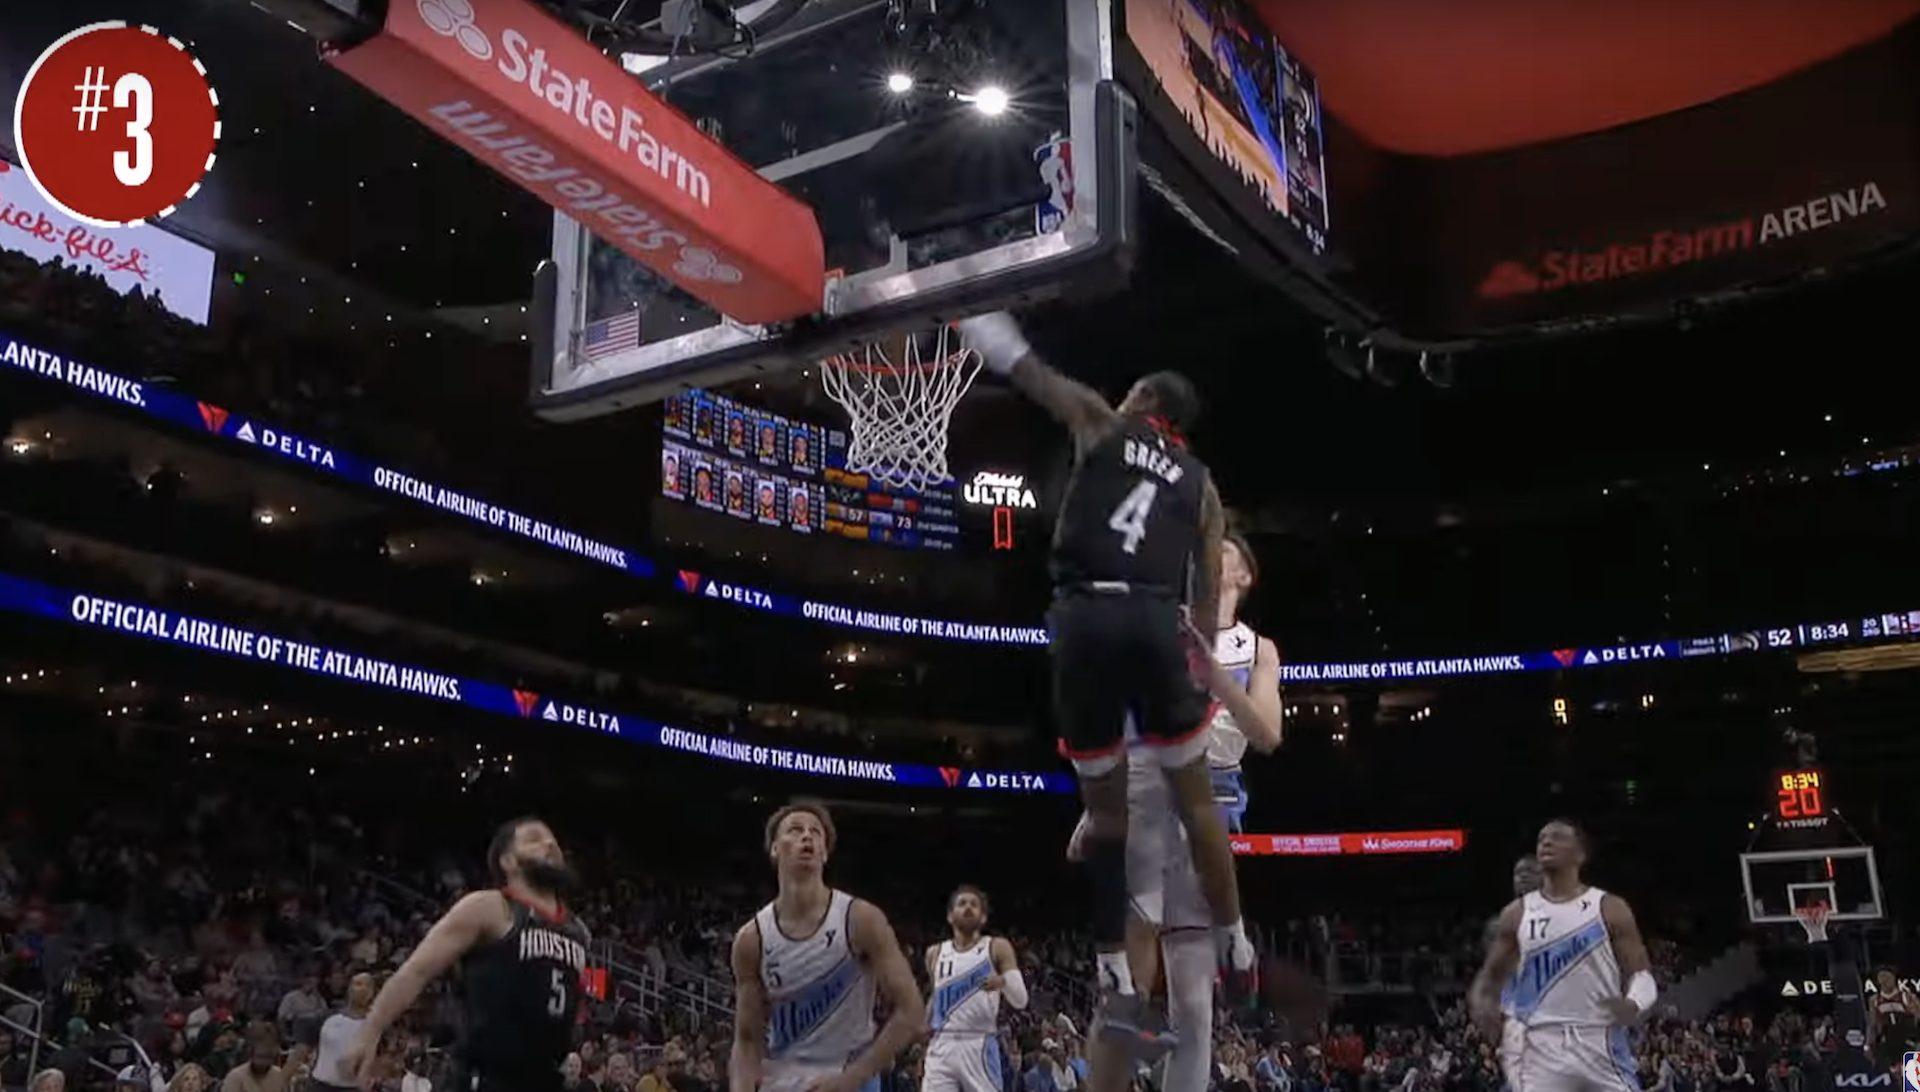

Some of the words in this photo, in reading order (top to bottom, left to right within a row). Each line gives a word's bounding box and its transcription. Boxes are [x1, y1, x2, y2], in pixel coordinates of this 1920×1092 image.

[500, 29, 711, 208] StateFarm
[1759, 181, 1887, 244] ARENA
[0, 203, 149, 281] ick-fil-A
[0, 341, 62, 379] ANTA
[67, 361, 146, 406] HAWKS.
[262, 429, 335, 468] DELTA
[963, 484, 1037, 508] ULTRA
[374, 467, 434, 504] OFFICIAL
[436, 489, 487, 522] AIRLINE
[489, 506, 506, 527] OF
[507, 512, 531, 537] THE
[532, 521, 583, 554] ATLANTA
[584, 539, 627, 568] HAWKS.
[1109, 480, 1158, 554] 4
[721, 584, 773, 609] DELTA
[802, 601, 853, 625] OFFICIAL
[855, 611, 901, 632] AIRLINE
[902, 617, 919, 634] OF
[920, 620, 943, 637] THE
[945, 623, 999, 641] ATLANTA
[1000, 627, 1050, 644] HAWKS.
[1767, 629, 1793, 647] 52
[1811, 623, 1849, 640] 8:34
[71, 595, 169, 638] OFFICIAL
[174, 617, 253, 656] AIRLINE
[256, 635, 282, 661] OF
[285, 641, 320, 670] THE
[321, 650, 398, 688] ATLANTA
[400, 667, 461, 701] HAWKS.
[1602, 644, 1665, 662] DELTA
[1278, 664, 1321, 680] FFICIAL
[1322, 662, 1370, 679] AIRLINE
[1371, 662, 1391, 678] OF
[1390, 661, 1414, 677] THE
[1416, 658, 1472, 675] ATLANTA
[1474, 655, 1525, 672] HAWKS.
[562, 705, 620, 733] DELTA
[660, 726, 709, 754] OFFICIAL
[709, 737, 752, 762] AIRLINE
[753, 747, 769, 765] OF
[771, 749, 793, 769] THE
[795, 753, 847, 776] ATLANTA
[848, 760, 896, 781] HAWKS.
[986, 773, 1045, 790] DELTA
[1781, 772, 1819, 790] 8:34
[1778, 787, 1820, 817] 20
[1528, 918, 1551, 941] 17
[766, 962, 782, 988] 5
[940, 960, 953, 979] 11
[547, 966, 566, 1016] 5
[1803, 979, 1878, 995] DEA
